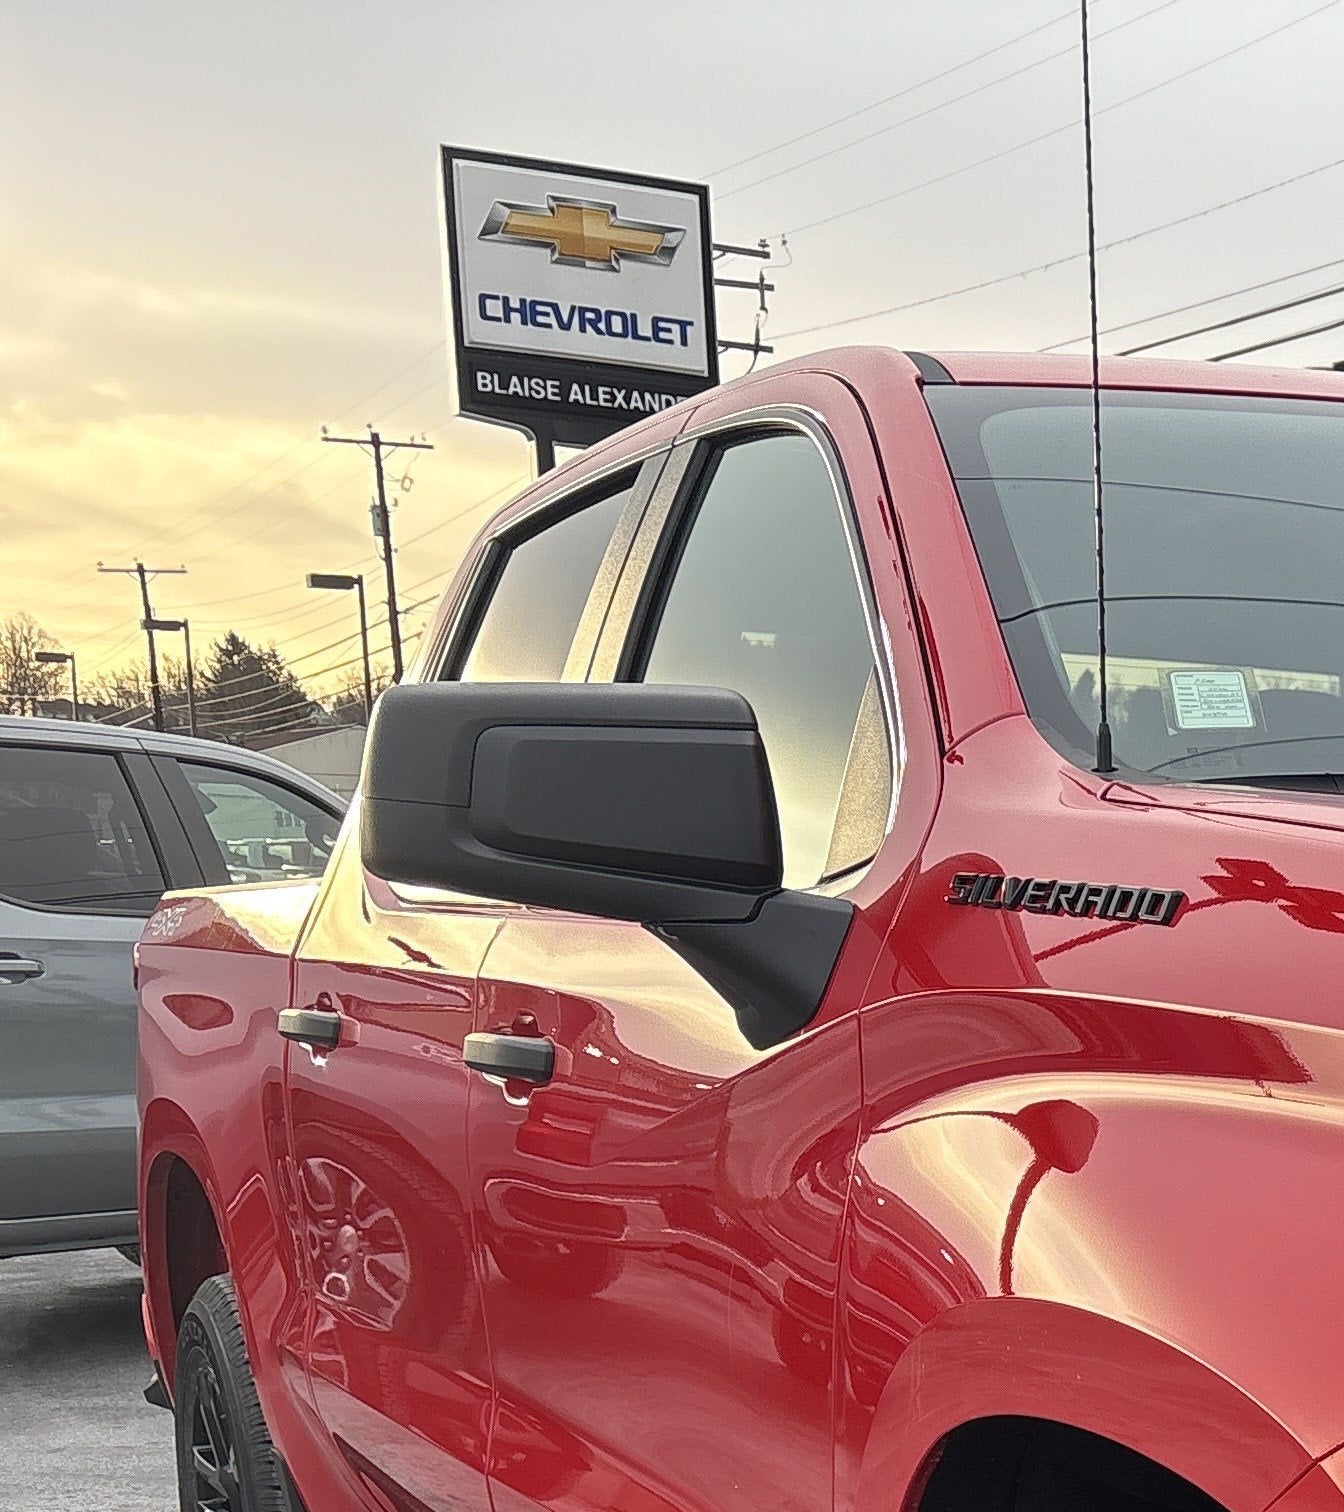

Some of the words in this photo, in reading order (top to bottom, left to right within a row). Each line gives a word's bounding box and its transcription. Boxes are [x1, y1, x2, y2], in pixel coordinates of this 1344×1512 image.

[477, 292, 694, 347] CHEVROLET
[476, 371, 562, 402] BLAISE
[568, 381, 689, 413] ALEXAND
[948, 872, 1186, 926] SILVERADO
